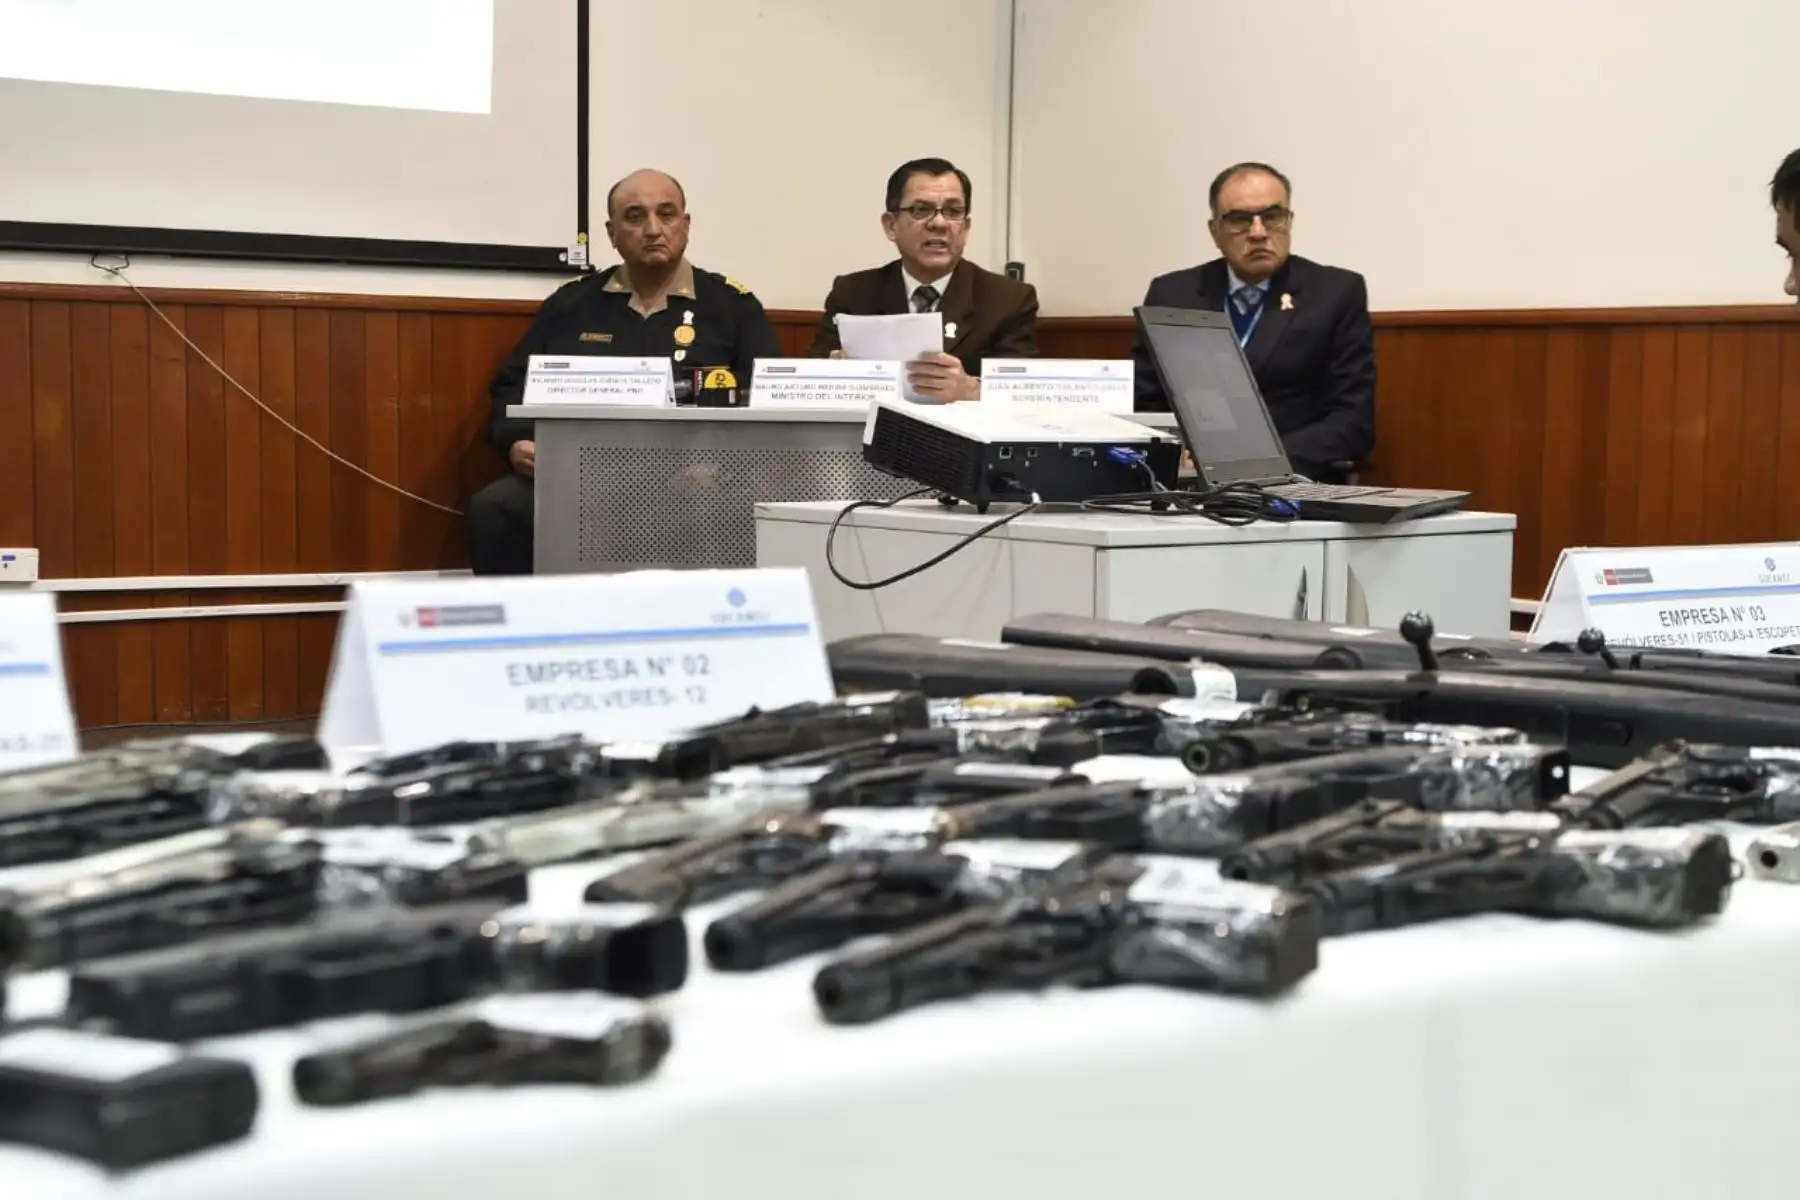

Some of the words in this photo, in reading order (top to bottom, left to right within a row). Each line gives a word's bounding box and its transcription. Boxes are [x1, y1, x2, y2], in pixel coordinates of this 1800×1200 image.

[771, 393, 814, 401] MINISTRO
[815, 393, 832, 401] DEL
[834, 393, 877, 402] INTERIOR
[1011, 394, 1101, 404] SUPERINTENDENTE
[1659, 608, 1729, 627] EMPRESA
[1749, 605, 1766, 621] 03
[505, 657, 639, 686] EMPRESA
[682, 654, 710, 676] 02
